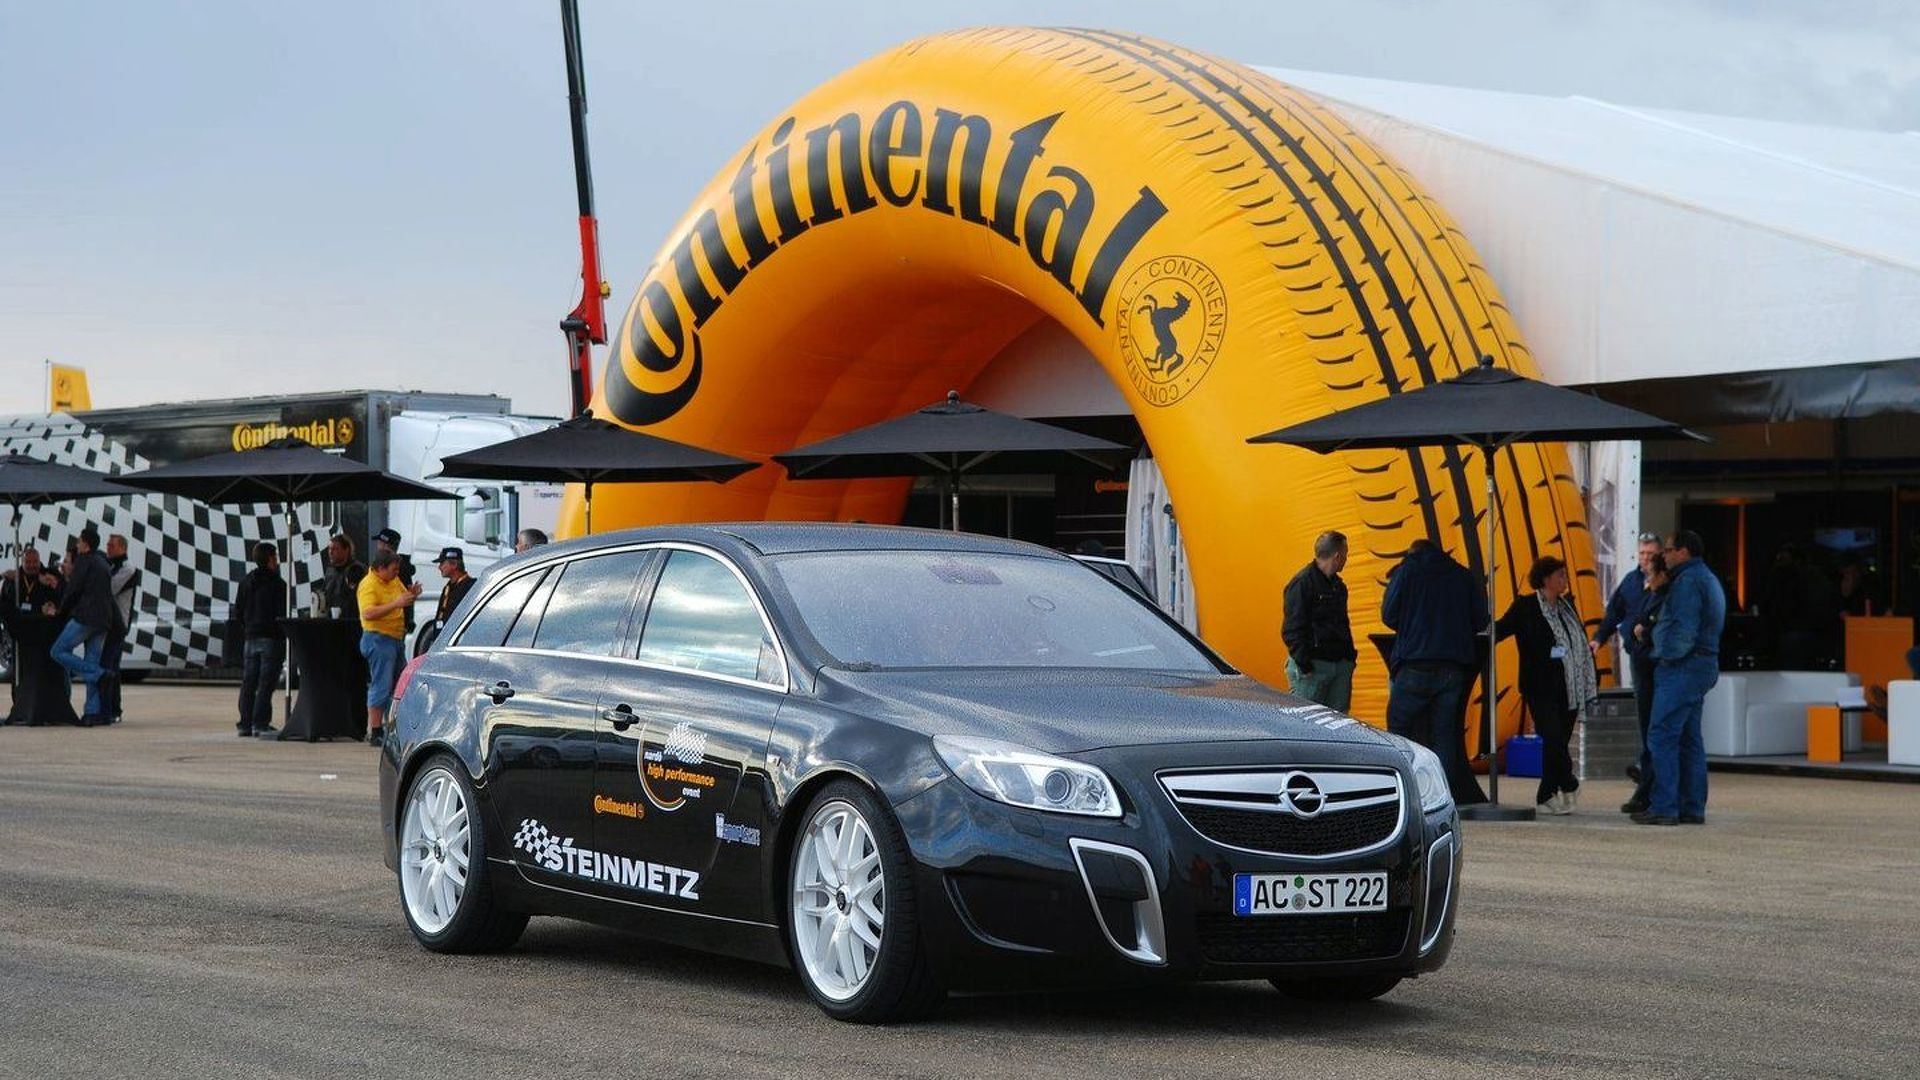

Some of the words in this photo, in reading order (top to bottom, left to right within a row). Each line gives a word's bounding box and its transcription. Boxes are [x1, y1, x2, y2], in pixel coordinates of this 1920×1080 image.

[604, 99, 1169, 426] Continental
[1119, 295, 1179, 403] CONTINENTAL
[1149, 258, 1224, 366] CONTINENTAL
[647, 762, 664, 778] high
[665, 768, 716, 787] performance
[545, 844, 700, 900] STEINMETZ
[1253, 879, 1289, 909] AC
[1308, 878, 1340, 908] ST
[1344, 877, 1385, 907] 222
